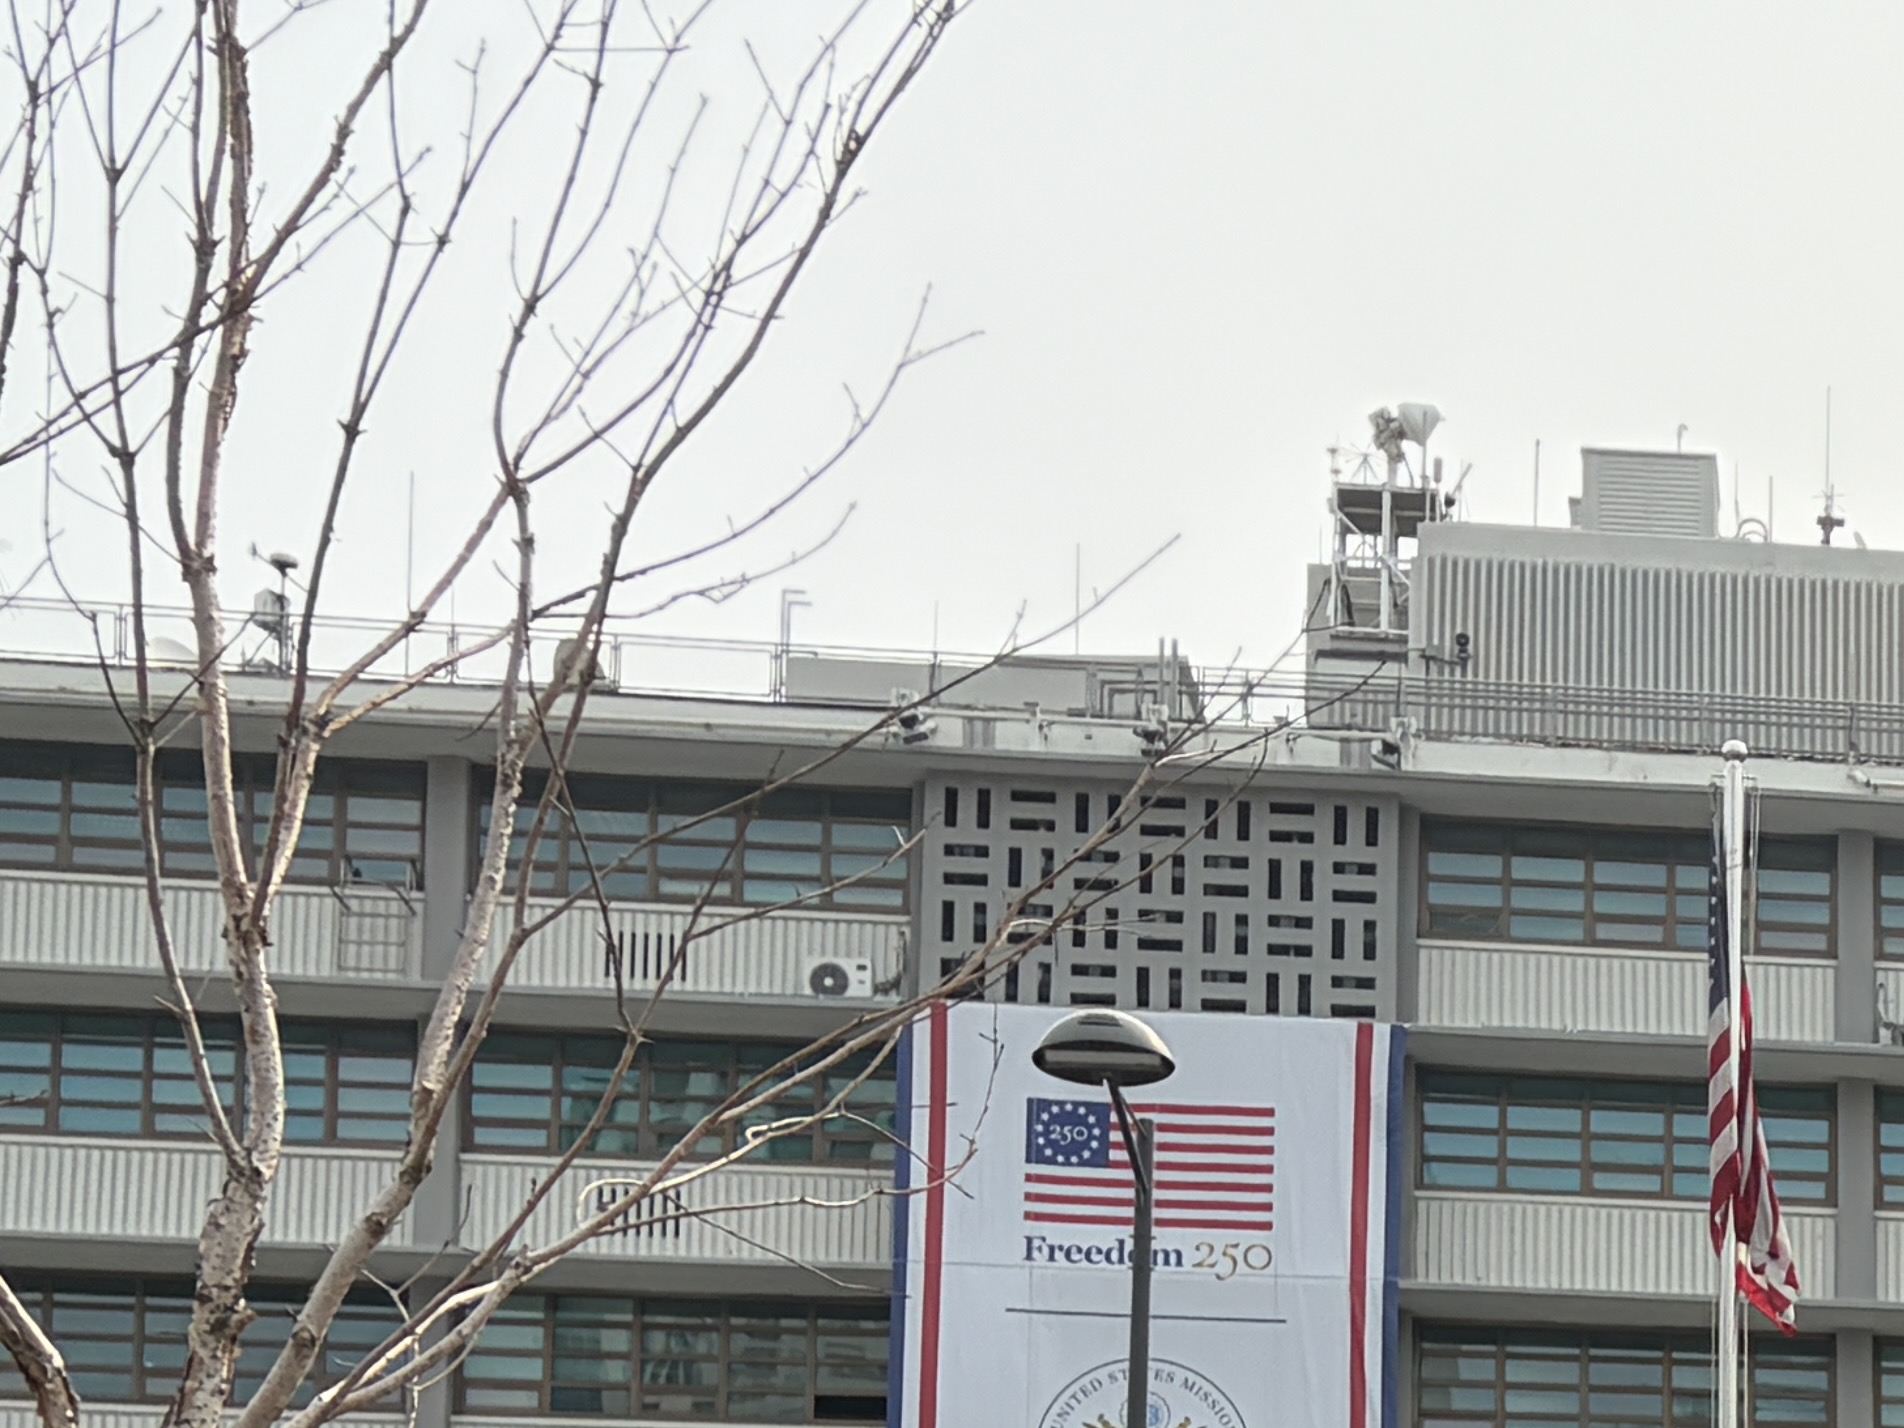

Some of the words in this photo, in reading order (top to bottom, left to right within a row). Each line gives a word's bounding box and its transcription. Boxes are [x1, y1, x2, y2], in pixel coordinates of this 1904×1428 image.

[1049, 1124, 1088, 1145] 250
[1191, 1241, 1273, 1281] 250
[1107, 1367, 1175, 1385] STES
